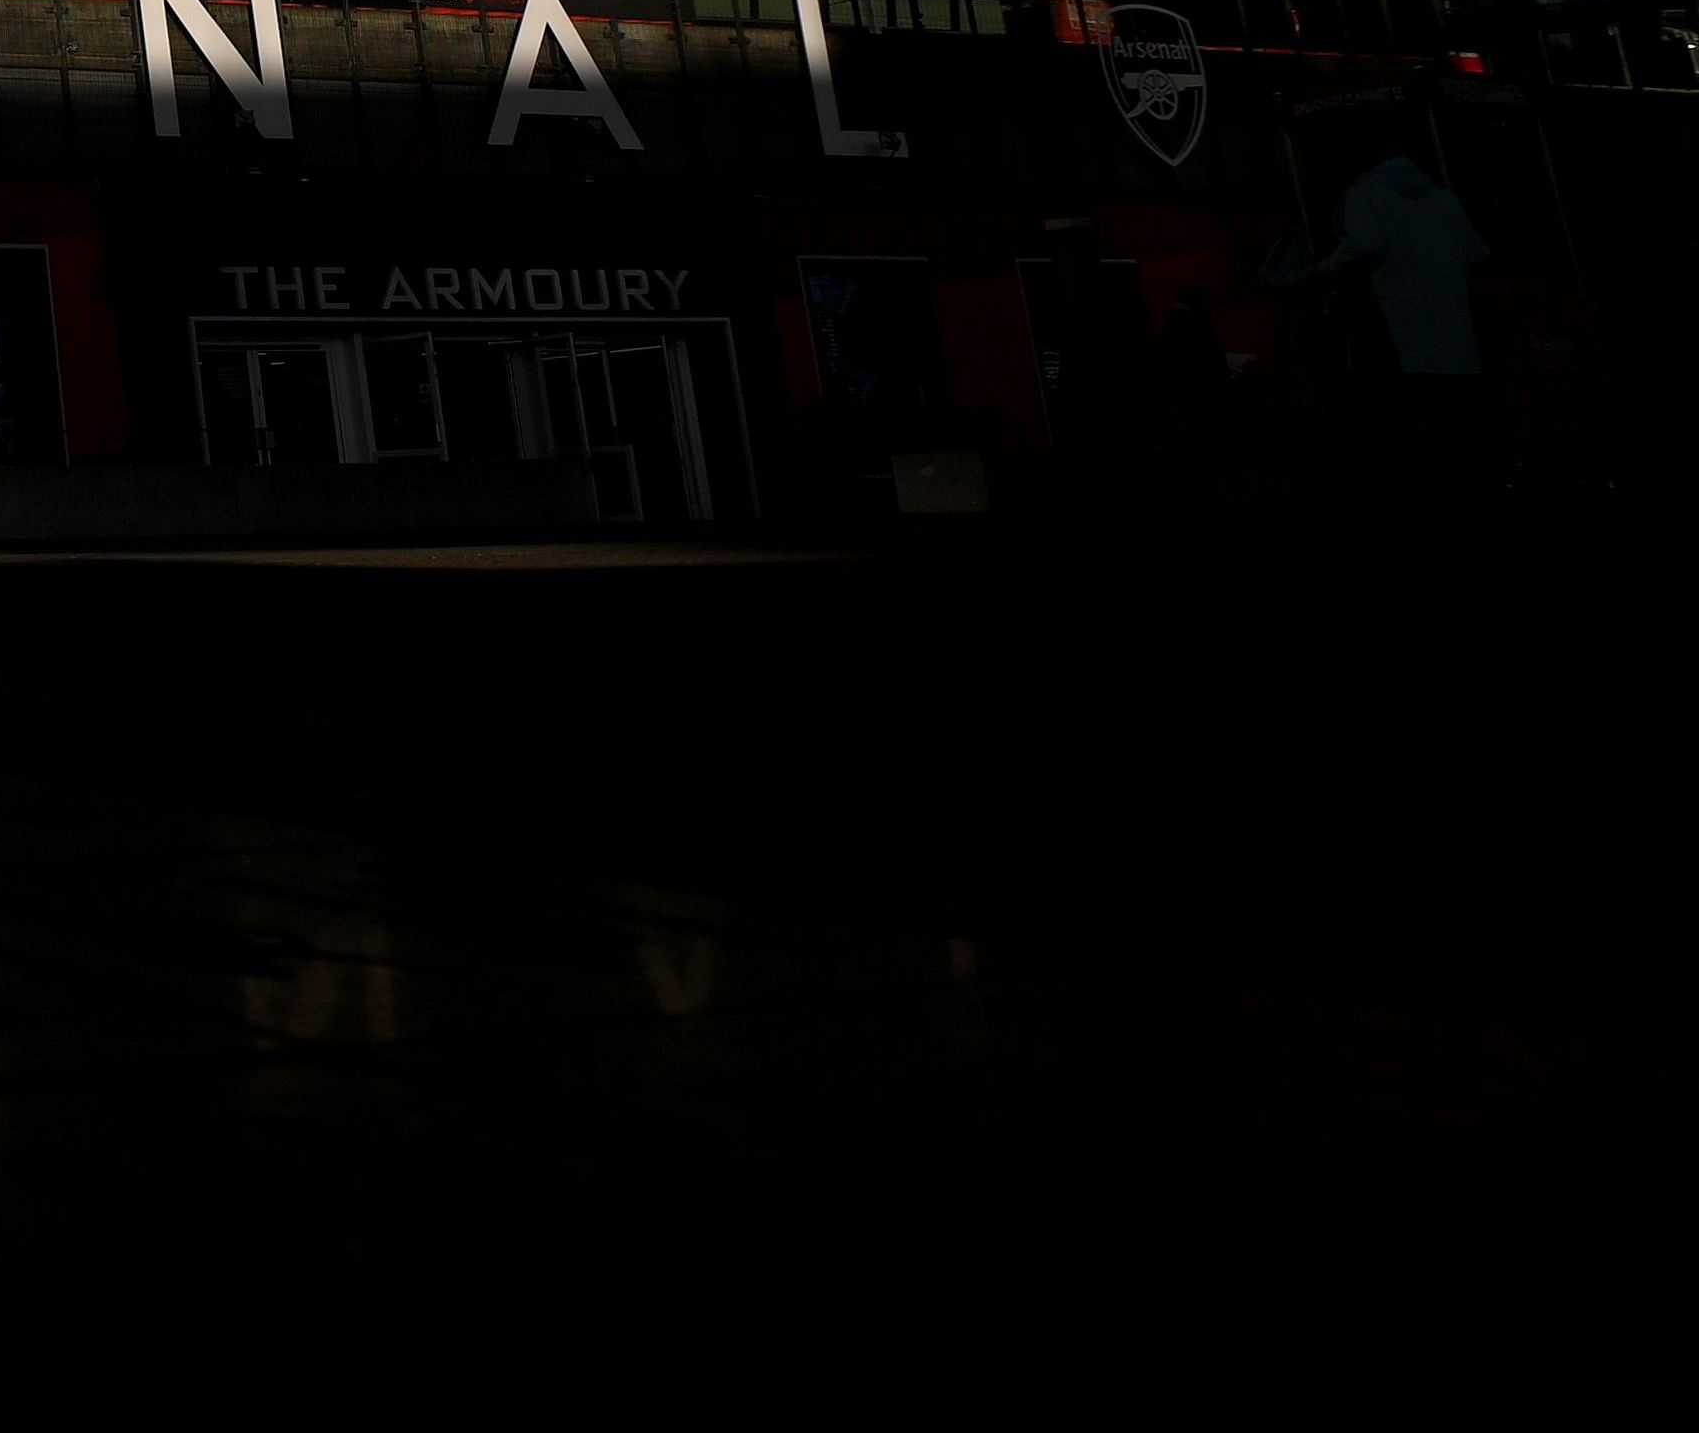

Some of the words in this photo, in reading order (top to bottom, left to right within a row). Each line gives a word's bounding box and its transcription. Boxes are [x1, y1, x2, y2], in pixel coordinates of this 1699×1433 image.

[1113, 35, 1195, 61] Arsenal
[219, 266, 350, 310] THE
[380, 267, 689, 311] ARMOURY
